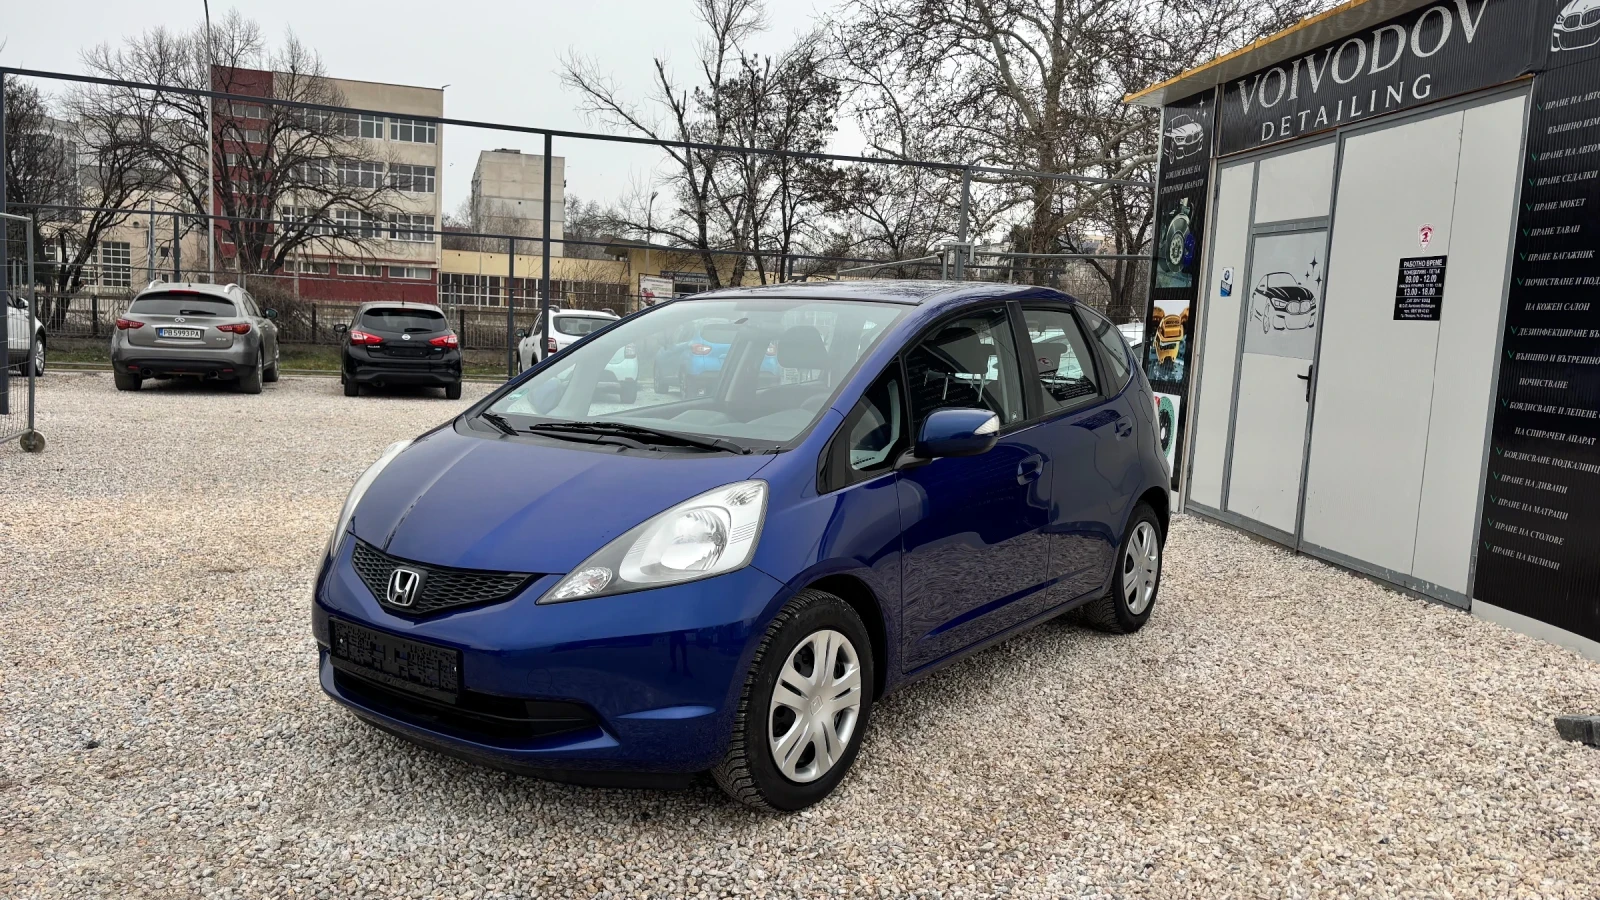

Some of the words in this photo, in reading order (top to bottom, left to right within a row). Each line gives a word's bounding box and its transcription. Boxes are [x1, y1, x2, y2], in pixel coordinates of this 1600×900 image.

[1237, 0, 1488, 116] VOIVODOV
[1261, 73, 1432, 142] DETAILING
[1545, 97, 1570, 109] ПРАНЕ
[1570, 95, 1582, 104] НА
[1547, 120, 1582, 134] ВЪНШНО
[1539, 149, 1564, 160] ПРАНЕ
[1564, 148, 1576, 156] НА
[1536, 175, 1562, 186] ПРАНЕ
[1562, 170, 1598, 182] СЕДАЛКИ
[1533, 201, 1559, 211] ПРАНЕ
[1558, 198, 1587, 208] МОКЕТ
[1530, 227, 1556, 236] ПРАНЕ
[1556, 224, 1581, 234] ТАВАН
[1527, 253, 1553, 261] ПРАНЕ
[1552, 250, 1596, 259] БАГАЖНИК
[1524, 277, 1575, 286] ПОЧИСТВАНЕ
[1524, 302, 1536, 310] НА
[1535, 302, 1564, 310] КОЖЕН
[1563, 302, 1591, 310] САЛОН
[174, 329, 190, 337] 5993
[1517, 327, 1589, 337] ДЕЗИНФЕКЦИРАНЕ
[1515, 352, 1549, 361] ВЪНШНО
[1556, 354, 1600, 364] ВЪТРЕШНО
[1518, 377, 1569, 388] ПОЧИСТВАНЕ
[1509, 401, 1558, 413] БОЯДИСВАНЕ
[1564, 408, 1598, 418] ЛЕПЕНЕ
[1514, 426, 1525, 434] НА
[1525, 428, 1566, 440] СПИРАЧЕН
[1565, 434, 1597, 445] АПАРАТ
[1503, 450, 1552, 464] БОЯДИСВАНЕ
[1500, 474, 1525, 484] ПРАНЕ
[1534, 482, 1568, 494] ДИВАНИ
[1497, 498, 1522, 509] ПРАНЕ
[1521, 503, 1533, 512] НА
[1532, 506, 1569, 520] МАТРАЦИ
[1494, 521, 1519, 533] ПРАНЕ
[1518, 527, 1530, 537] НА
[1529, 530, 1565, 545] СТОЛОВЕ
[1491, 545, 1516, 557] ПРАНЕ
[1515, 551, 1527, 560] НА
[1526, 555, 1561, 570] КИЛИМИ
